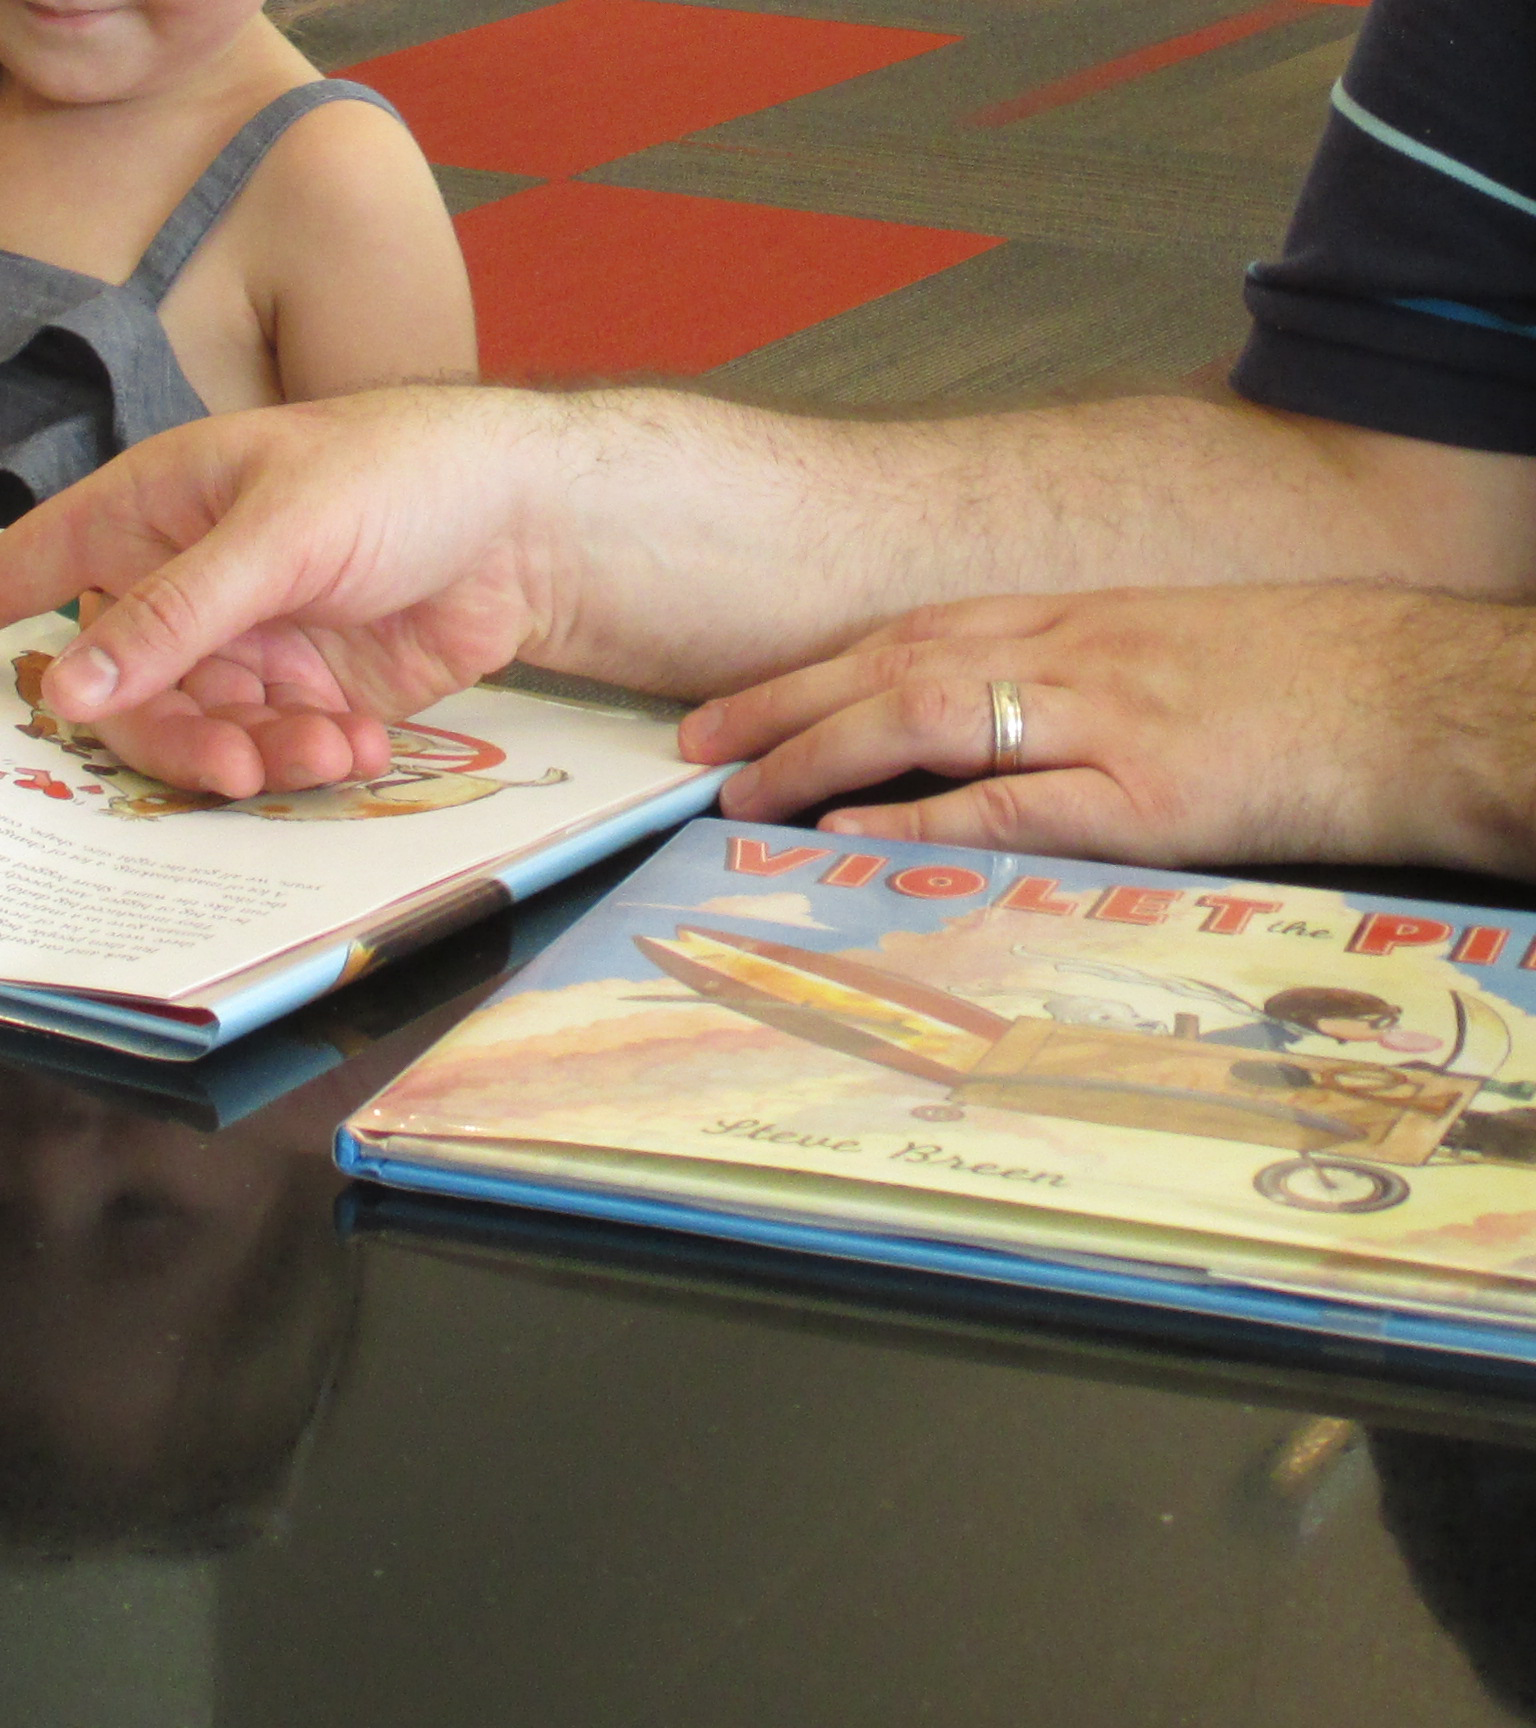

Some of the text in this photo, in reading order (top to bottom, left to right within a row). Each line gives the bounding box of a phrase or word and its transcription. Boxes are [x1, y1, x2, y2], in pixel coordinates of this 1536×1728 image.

[724, 836, 1283, 934] VIOLET
[1265, 919, 1335, 940] the
[701, 1118, 1067, 1188] Steve Breen
